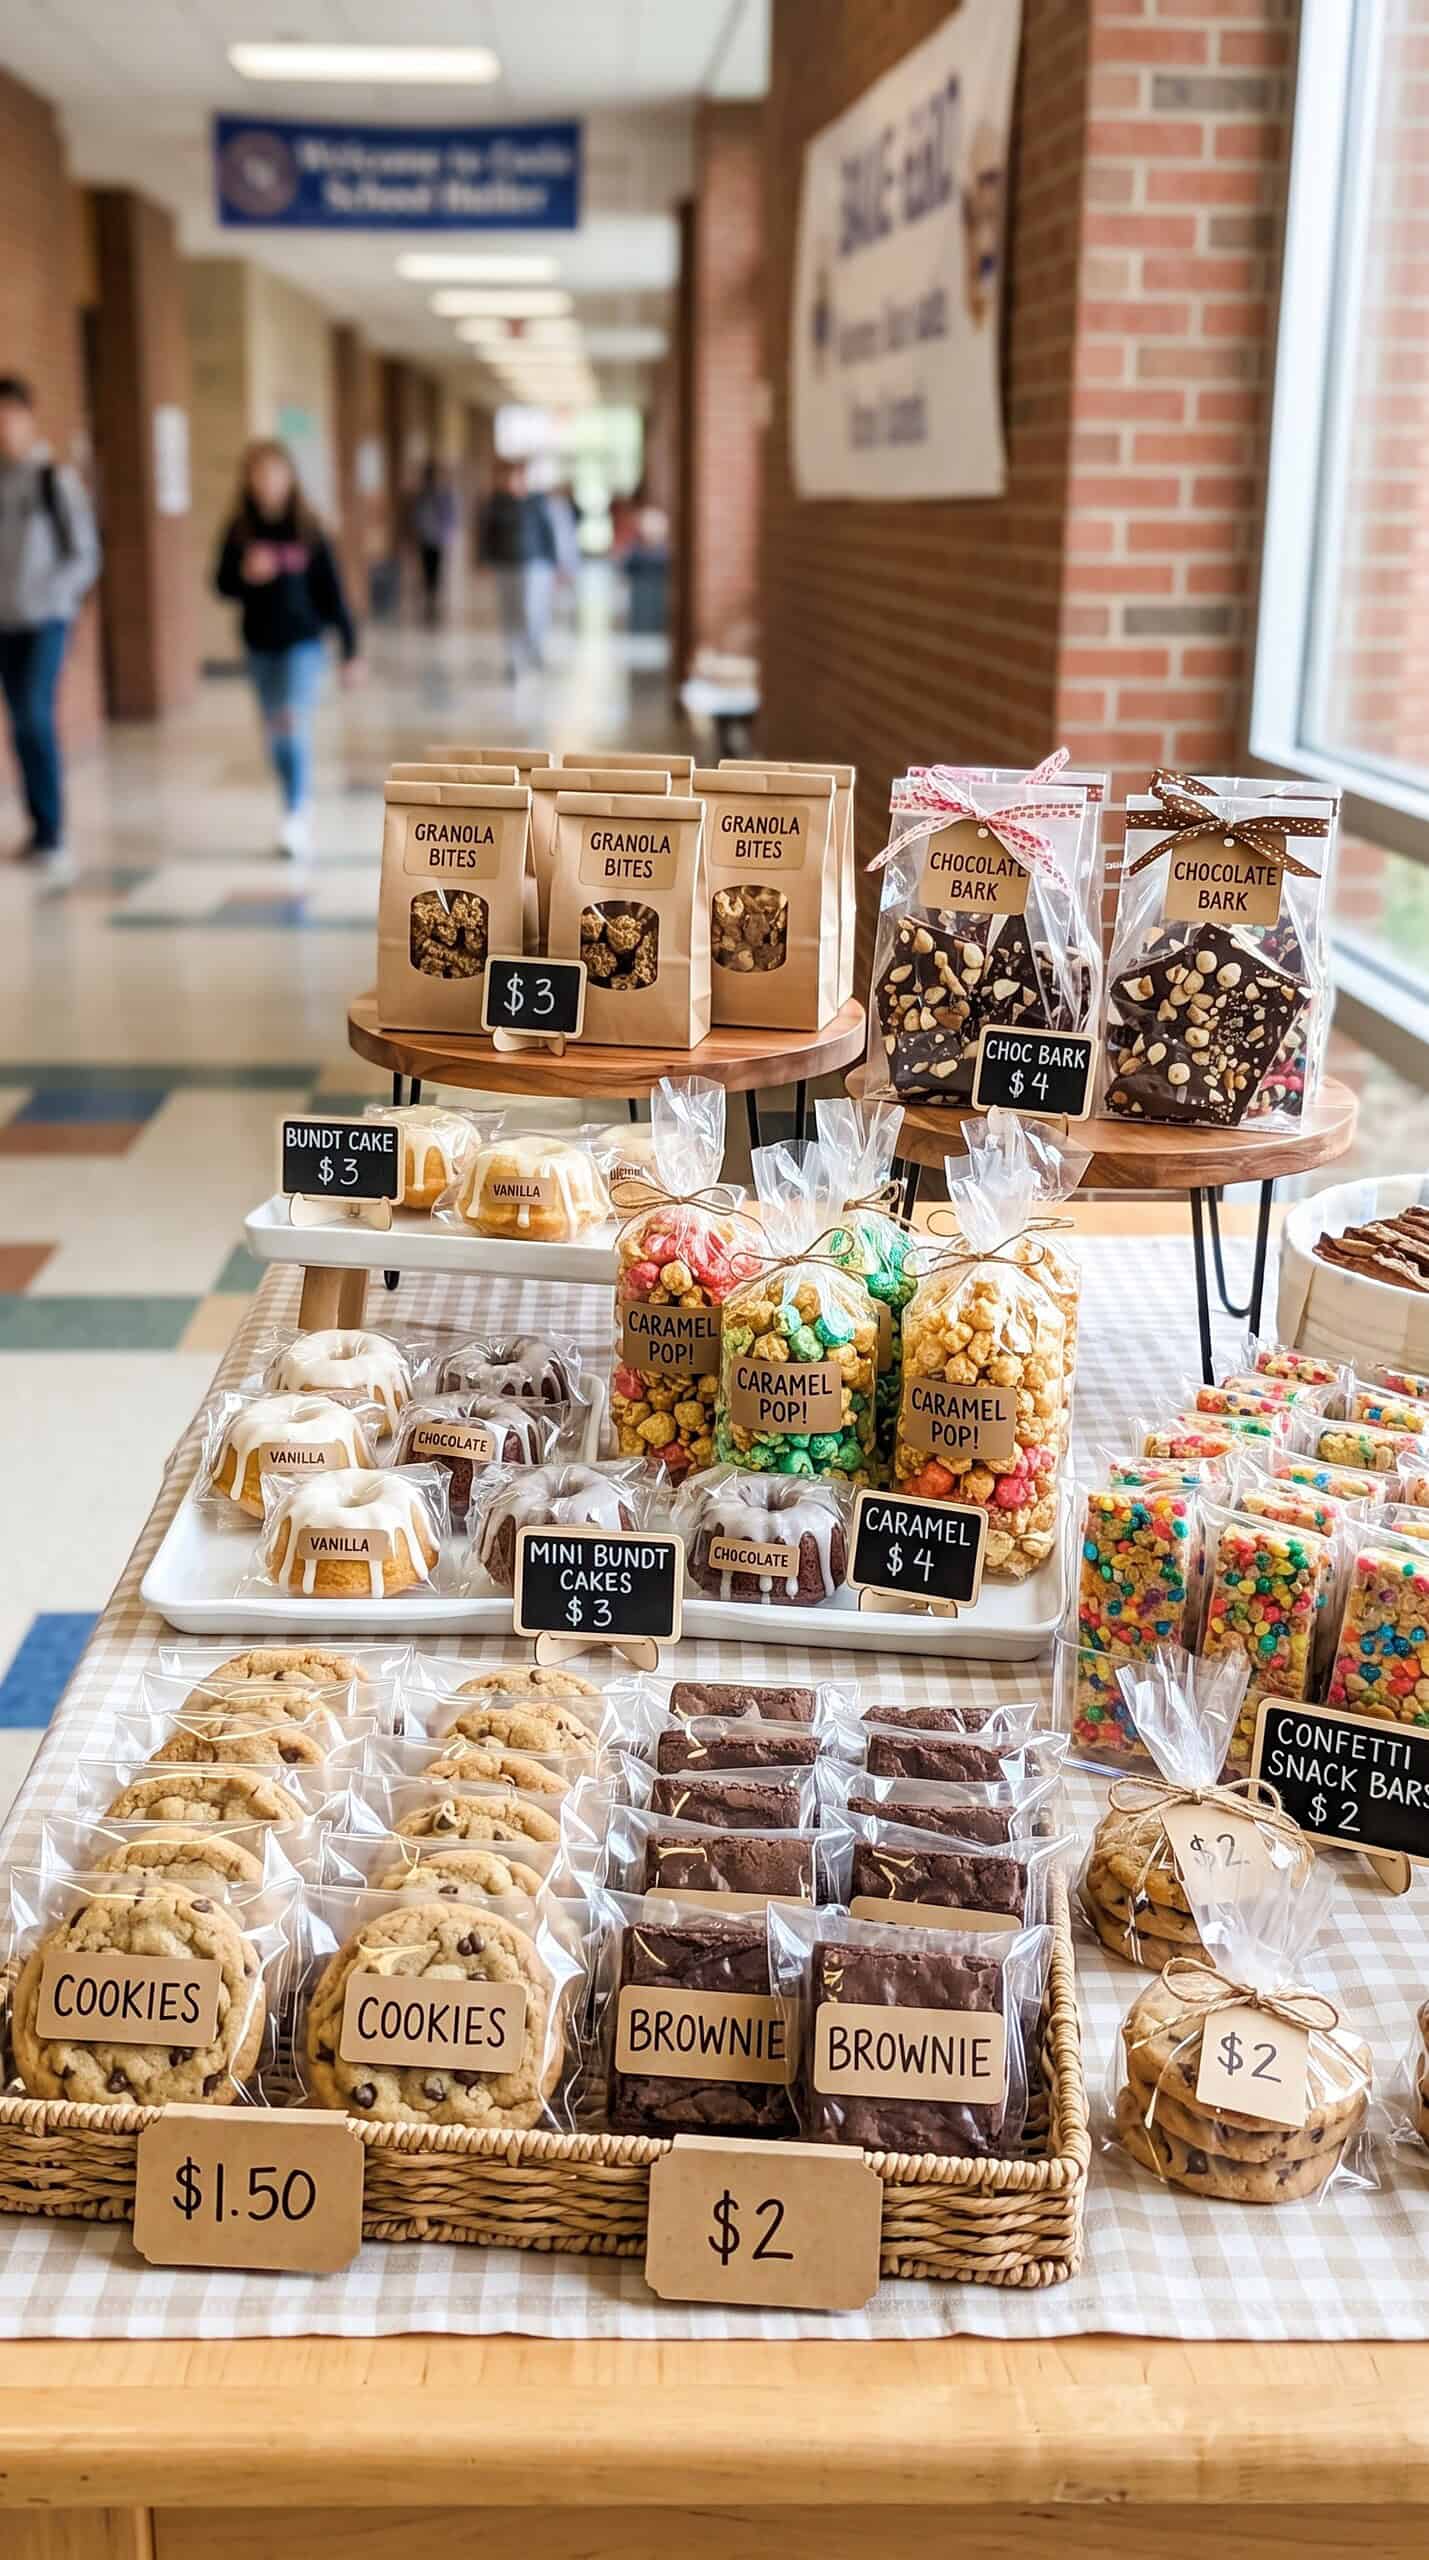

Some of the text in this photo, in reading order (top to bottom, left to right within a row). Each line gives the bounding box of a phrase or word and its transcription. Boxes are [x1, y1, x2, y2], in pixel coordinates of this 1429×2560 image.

[415, 823, 494, 845] GRANOLA
[721, 815, 801, 836] GRANOLA
[590, 831, 671, 854] GRANOLA
[735, 839, 782, 859] BITES
[429, 848, 476, 868] BITES
[604, 858, 653, 879] BITES
[930, 851, 1027, 878] CHOCOLATE
[1174, 861, 1278, 886] CHOCOLATE
[950, 879, 998, 902] BARK
[1198, 890, 1248, 911] BARK
[985, 1038, 1086, 1069] CHOC BARK
[286, 1127, 394, 1153] BUNDT CAKE
[493, 1183, 541, 1198] VANILLA
[628, 1310, 718, 1339] CARAMEL
[649, 1340, 694, 1366] POP!
[737, 1367, 833, 1396] CARAMEL
[759, 1398, 808, 1425] POP!
[911, 1387, 1008, 1421] CARAMEL
[418, 1431, 488, 1453] CHOCOLATE
[931, 1424, 979, 1450] POP!
[269, 1450, 326, 1465] VANILLA
[865, 1506, 972, 1547] CARAMEL
[310, 1537, 370, 1553] VANILLA
[530, 1541, 670, 1570] MINI BUNDT
[714, 1546, 789, 1568] CHOCOLATE
[560, 1569, 633, 1594] CAKES
[1277, 1718, 1412, 1770] CONFETTI
[1267, 1750, 1358, 1793] SNACK
[54, 1974, 201, 2024] COOKIES
[357, 1996, 506, 2048] COOKIES
[629, 2008, 786, 2060] BROWNIE
[829, 2026, 991, 2078] BROWNIE
[1216, 2031, 1282, 2084] $2
[172, 2156, 316, 2223] $1.50
[708, 2189, 795, 2267] $2
